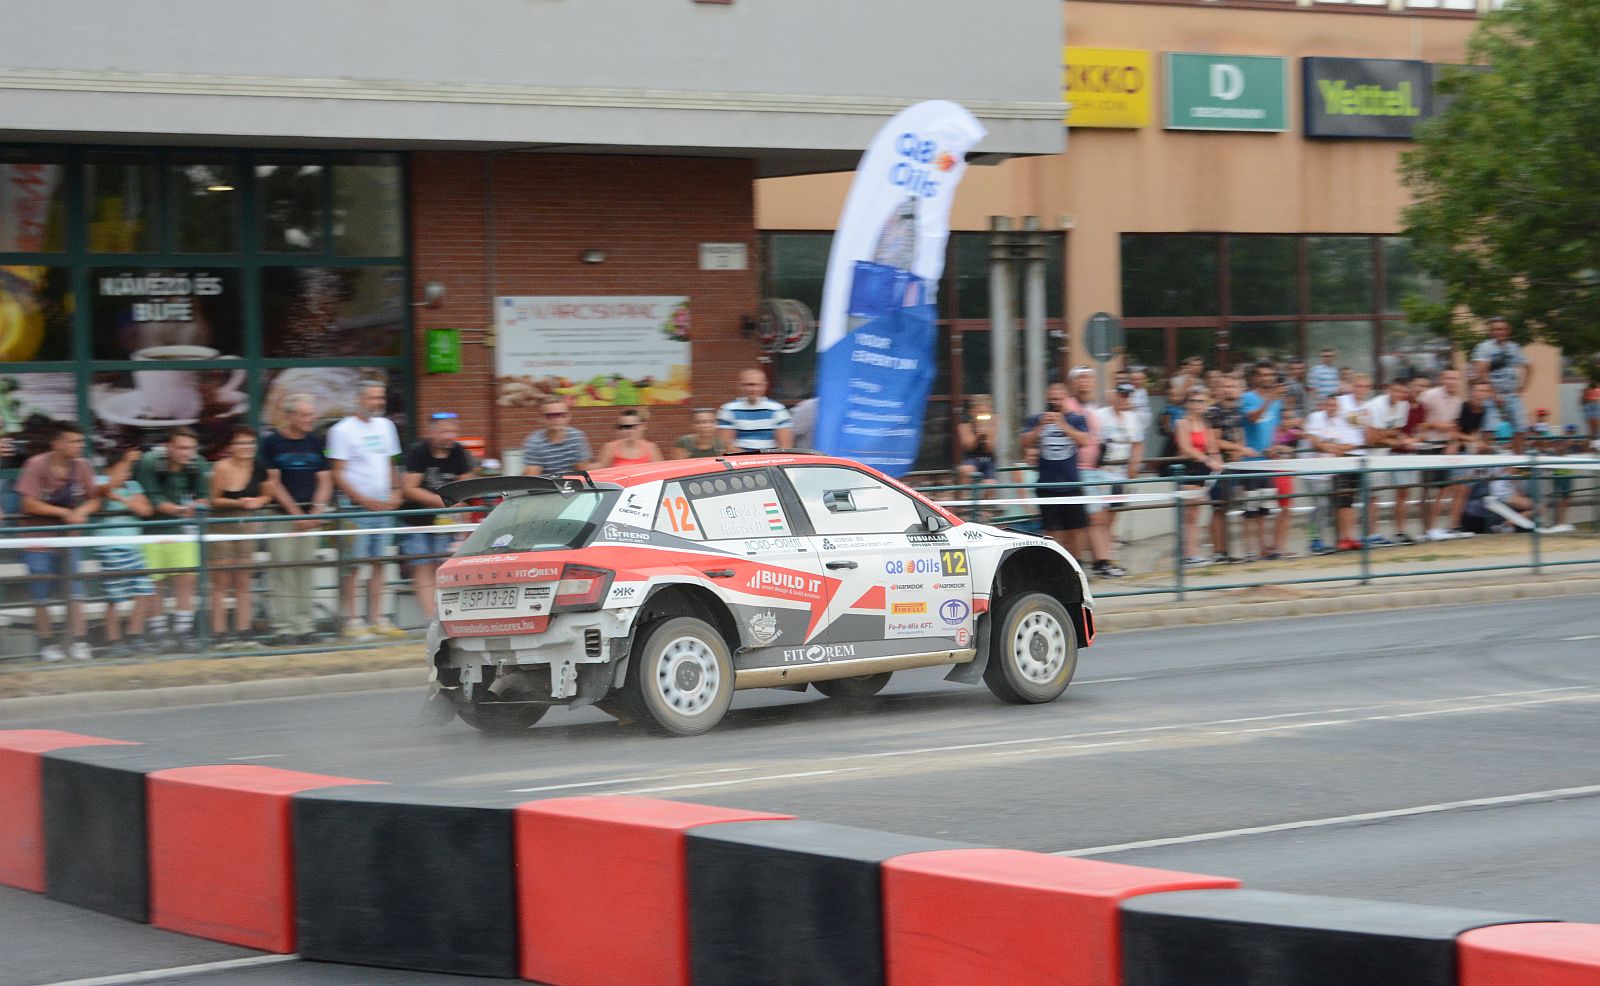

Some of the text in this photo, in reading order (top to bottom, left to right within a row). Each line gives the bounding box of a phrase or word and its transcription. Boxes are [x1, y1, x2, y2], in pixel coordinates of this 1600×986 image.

[1209, 63, 1245, 100] D
[895, 132, 937, 165] Q8
[888, 161, 942, 198] Oils
[662, 496, 695, 532] 12
[618, 531, 650, 540] TREND
[907, 534, 948, 542] VISUALIA
[885, 558, 940, 575] Q8 Oils
[942, 551, 967, 574] 12
[761, 570, 822, 592] BUILD IT
[469, 590, 516, 607] SP 13-26
[894, 603, 925, 614] PIRELLI
[959, 631, 966, 642] E
